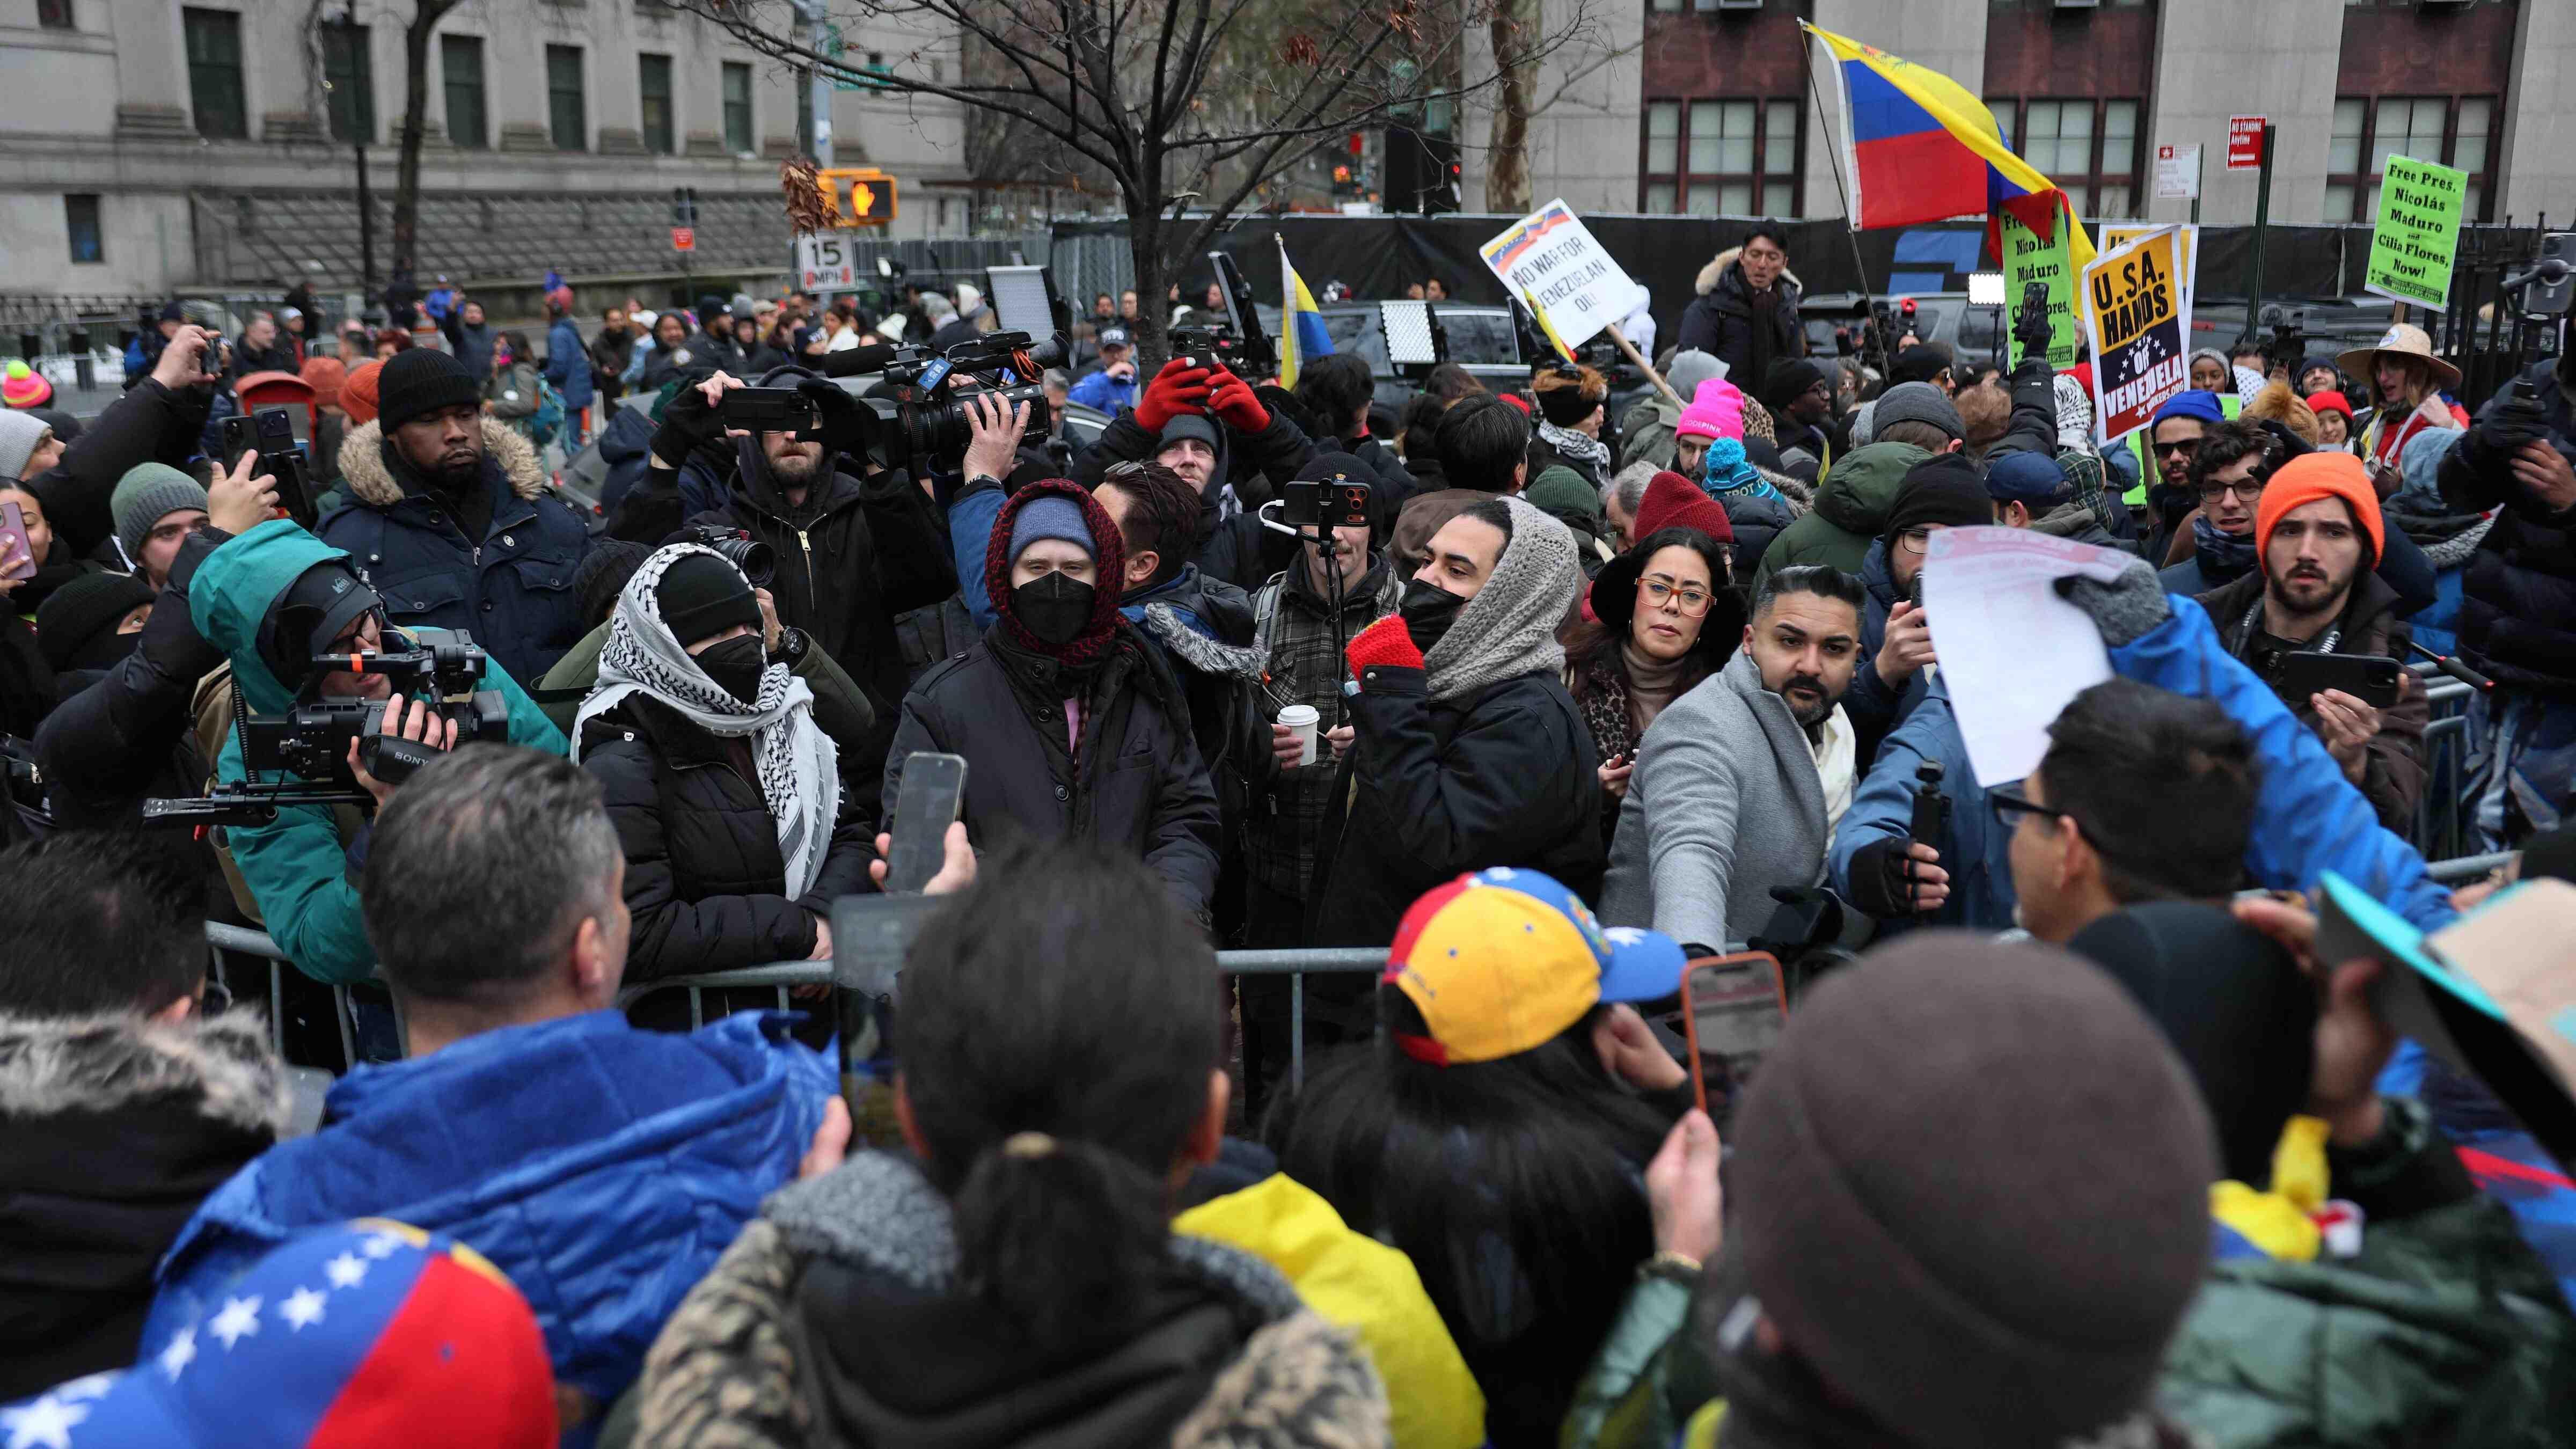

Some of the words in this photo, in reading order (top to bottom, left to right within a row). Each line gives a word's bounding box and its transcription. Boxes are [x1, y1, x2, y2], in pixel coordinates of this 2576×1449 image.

[2231, 120, 2239, 133] NO
[2240, 119, 2262, 133] STANDING
[2231, 133, 2250, 147] Anytime
[2389, 164, 2416, 183] Free
[2420, 172, 2456, 193] Pres.
[2395, 188, 2446, 212] Nicolás
[2004, 214, 2026, 231] Fr
[2390, 209, 2443, 233] Maduro
[809, 241, 841, 266] 15
[1530, 250, 1562, 275] WAR
[1557, 236, 1586, 261] FOR
[2379, 235, 2402, 252] Cilia
[2405, 244, 2448, 268] Flores,
[2017, 262, 2059, 282] Maduro
[2393, 258, 2426, 279] Now!
[2094, 250, 2165, 311] U.S.A.
[2046, 301, 2070, 316] ores,
[2102, 284, 2169, 348] HANDS
[1684, 420, 1722, 433] CODEPINK
[394, 751, 429, 766] SONY
